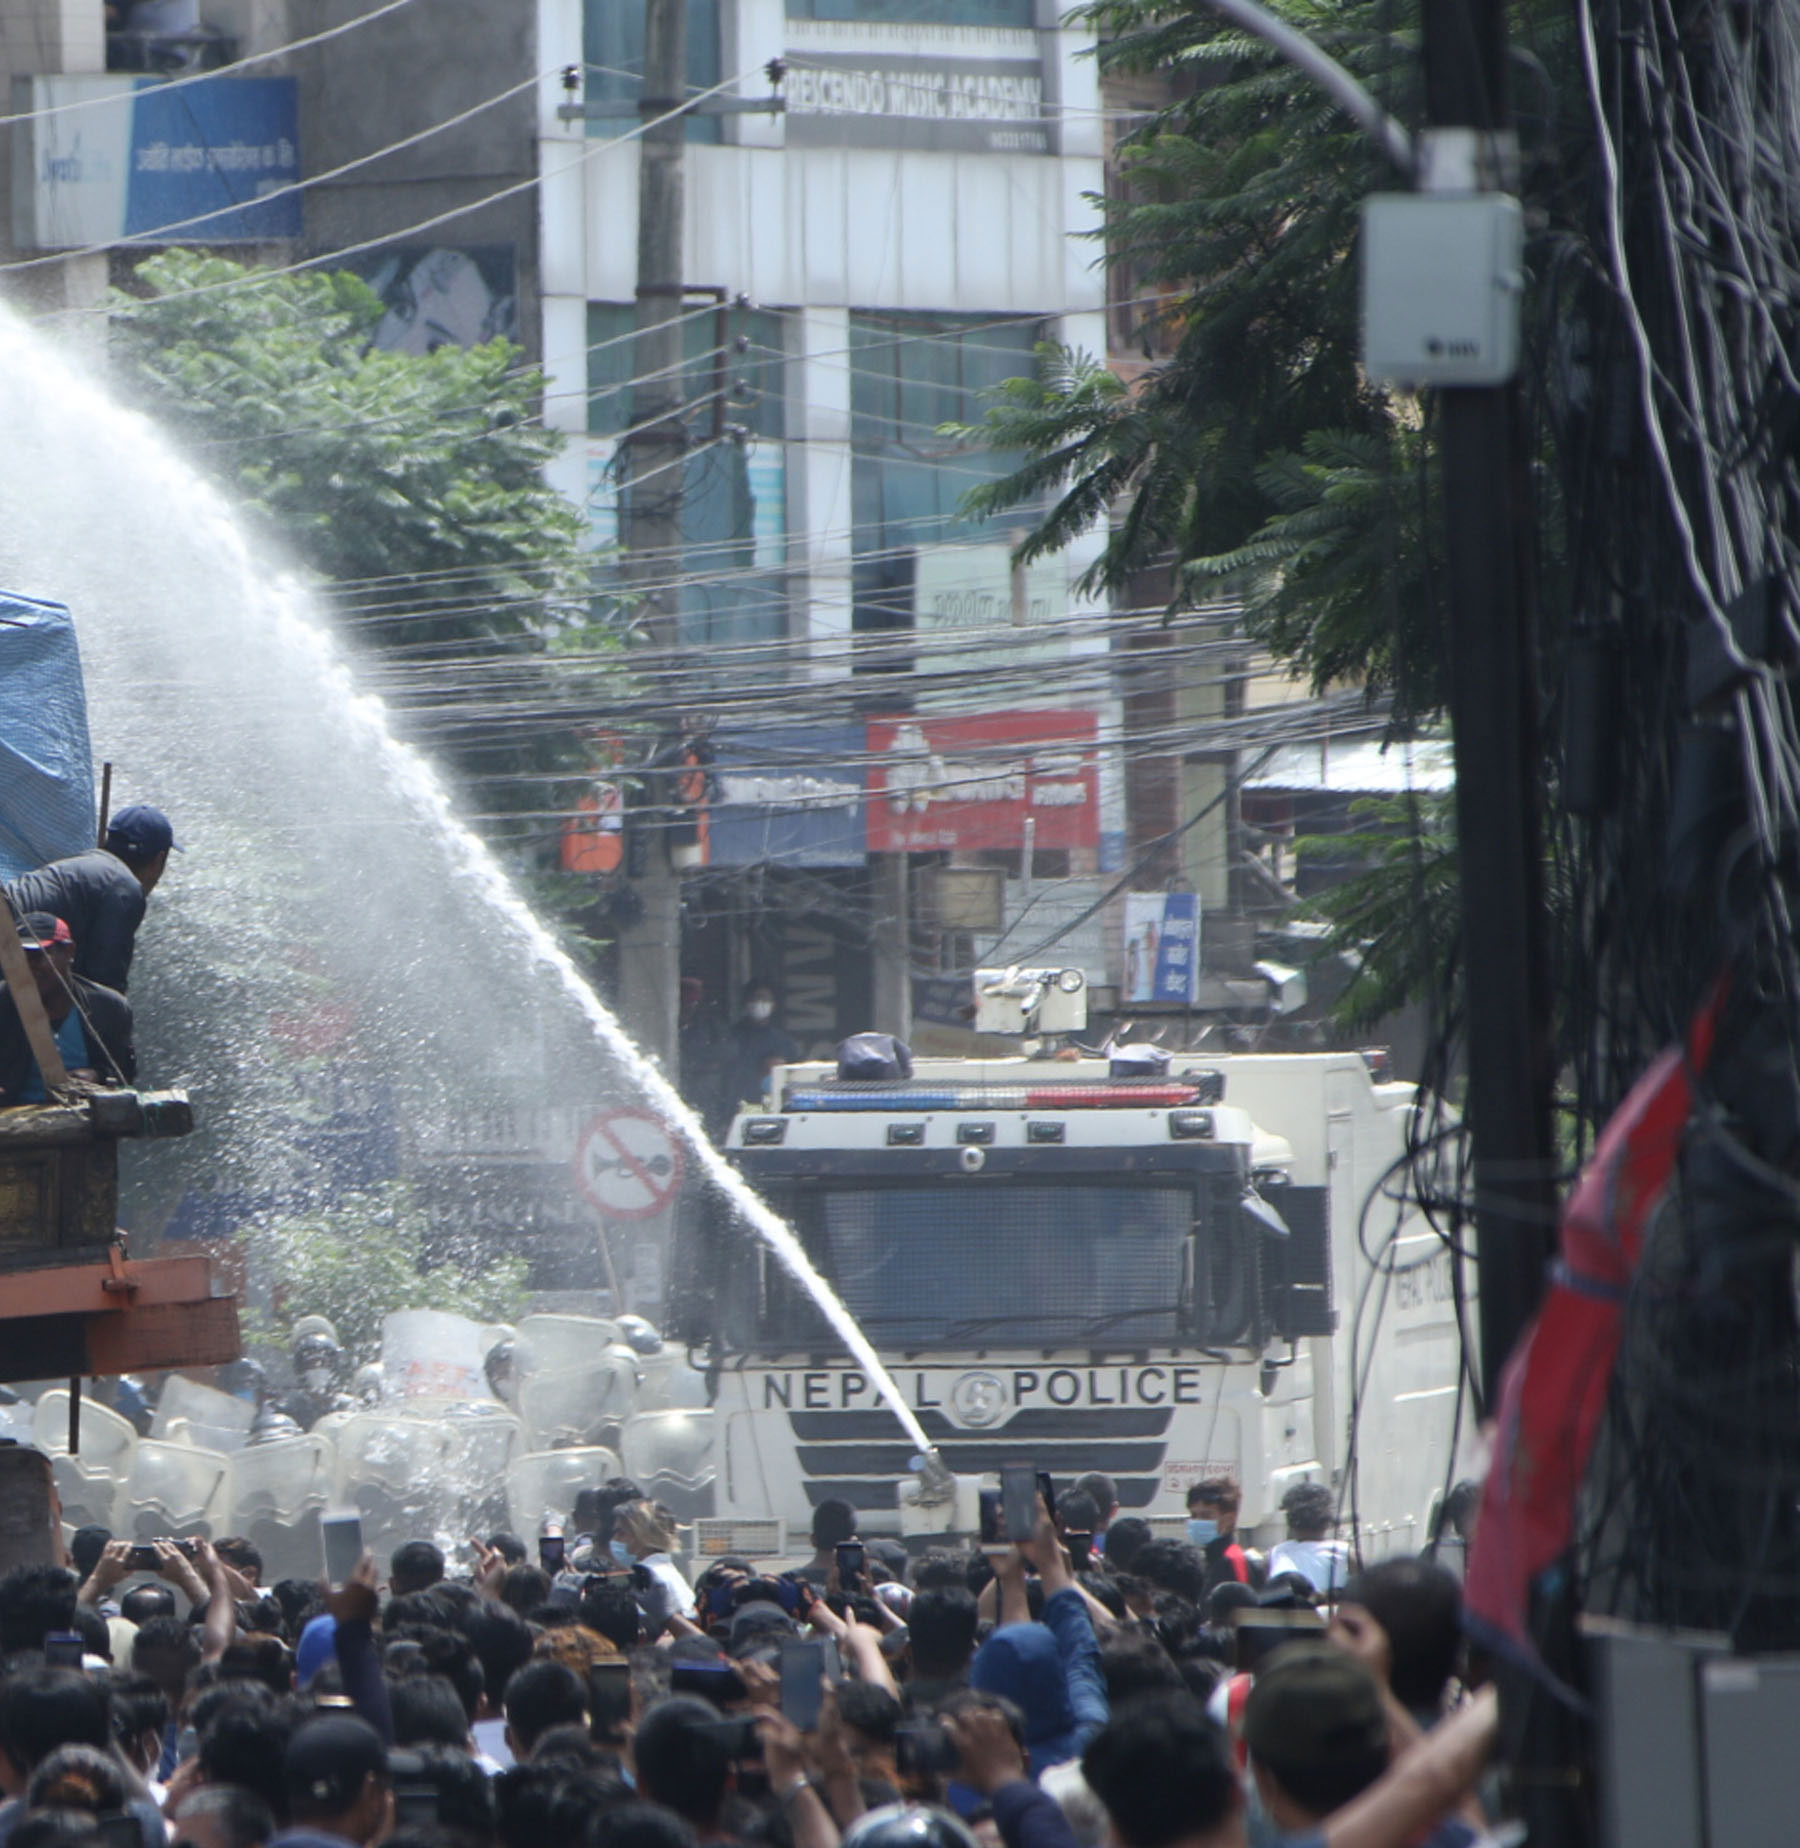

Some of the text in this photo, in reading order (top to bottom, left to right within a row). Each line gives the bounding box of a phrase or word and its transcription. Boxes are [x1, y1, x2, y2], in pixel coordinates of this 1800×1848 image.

[785, 68, 1042, 121] RESCENDO MUSIC ACADEMY
[1014, 1367, 1201, 1406] POLICE
